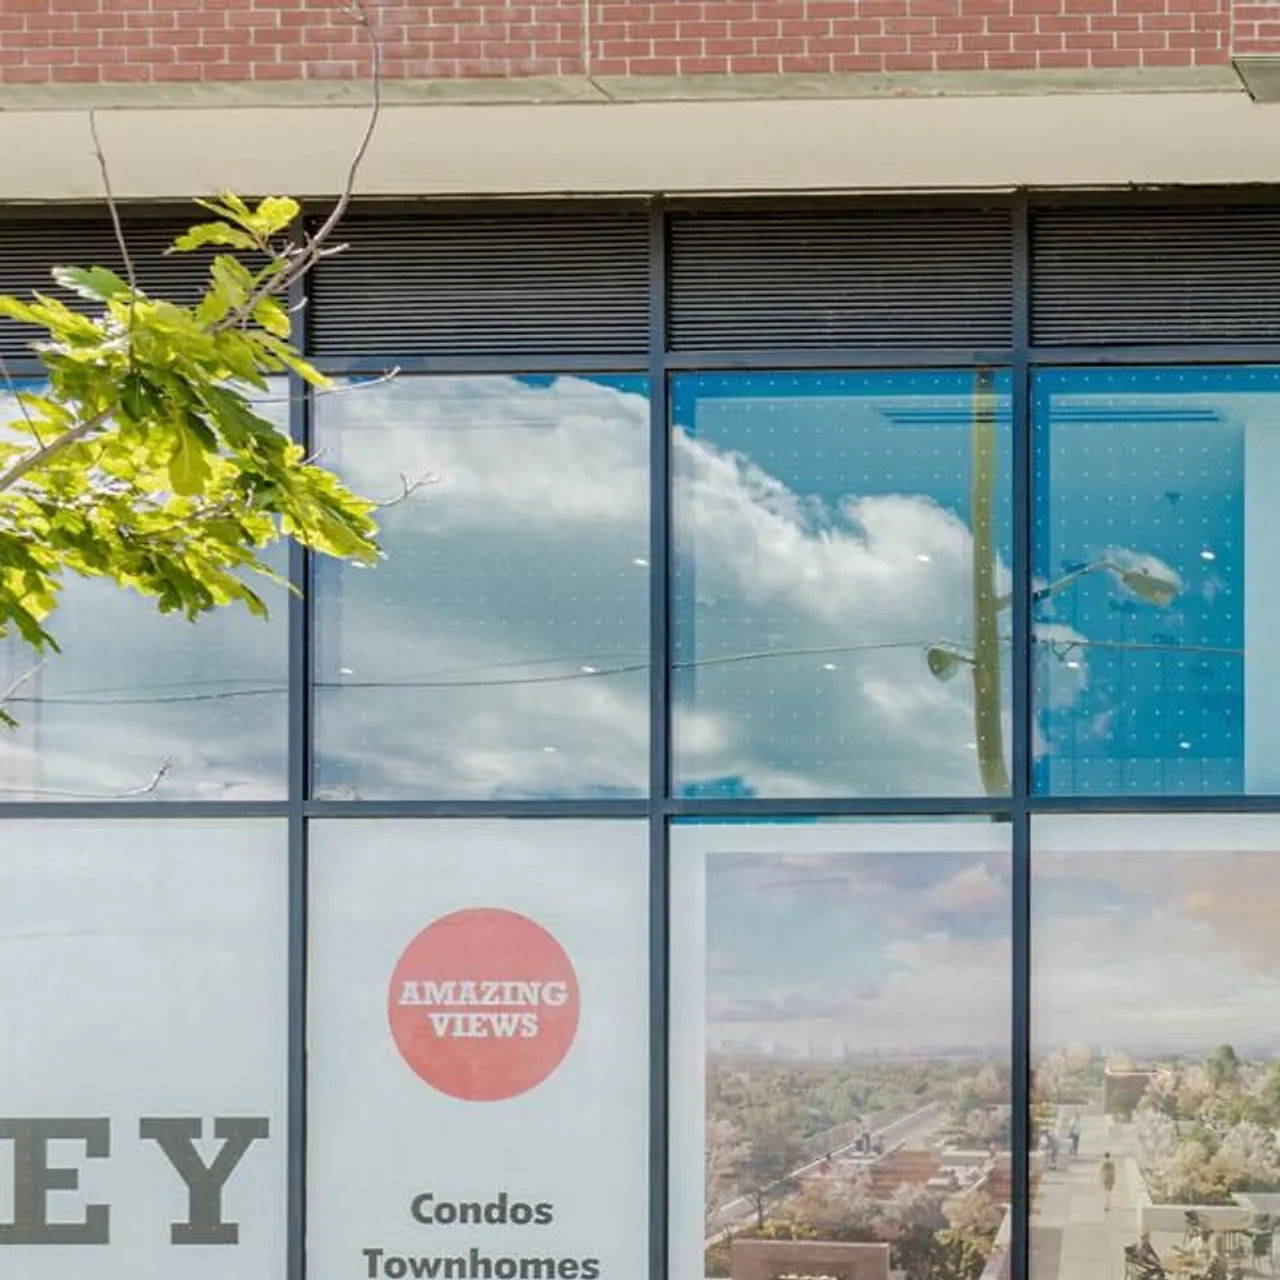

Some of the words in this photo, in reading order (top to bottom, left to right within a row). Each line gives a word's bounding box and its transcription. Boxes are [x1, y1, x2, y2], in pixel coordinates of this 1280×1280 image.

[398, 981, 568, 1006] AMAZING
[429, 1013, 539, 1038] VIEWS
[0, 1117, 270, 1245] EY
[410, 1193, 554, 1226] Condos
[363, 1248, 600, 1280] Townhomes
